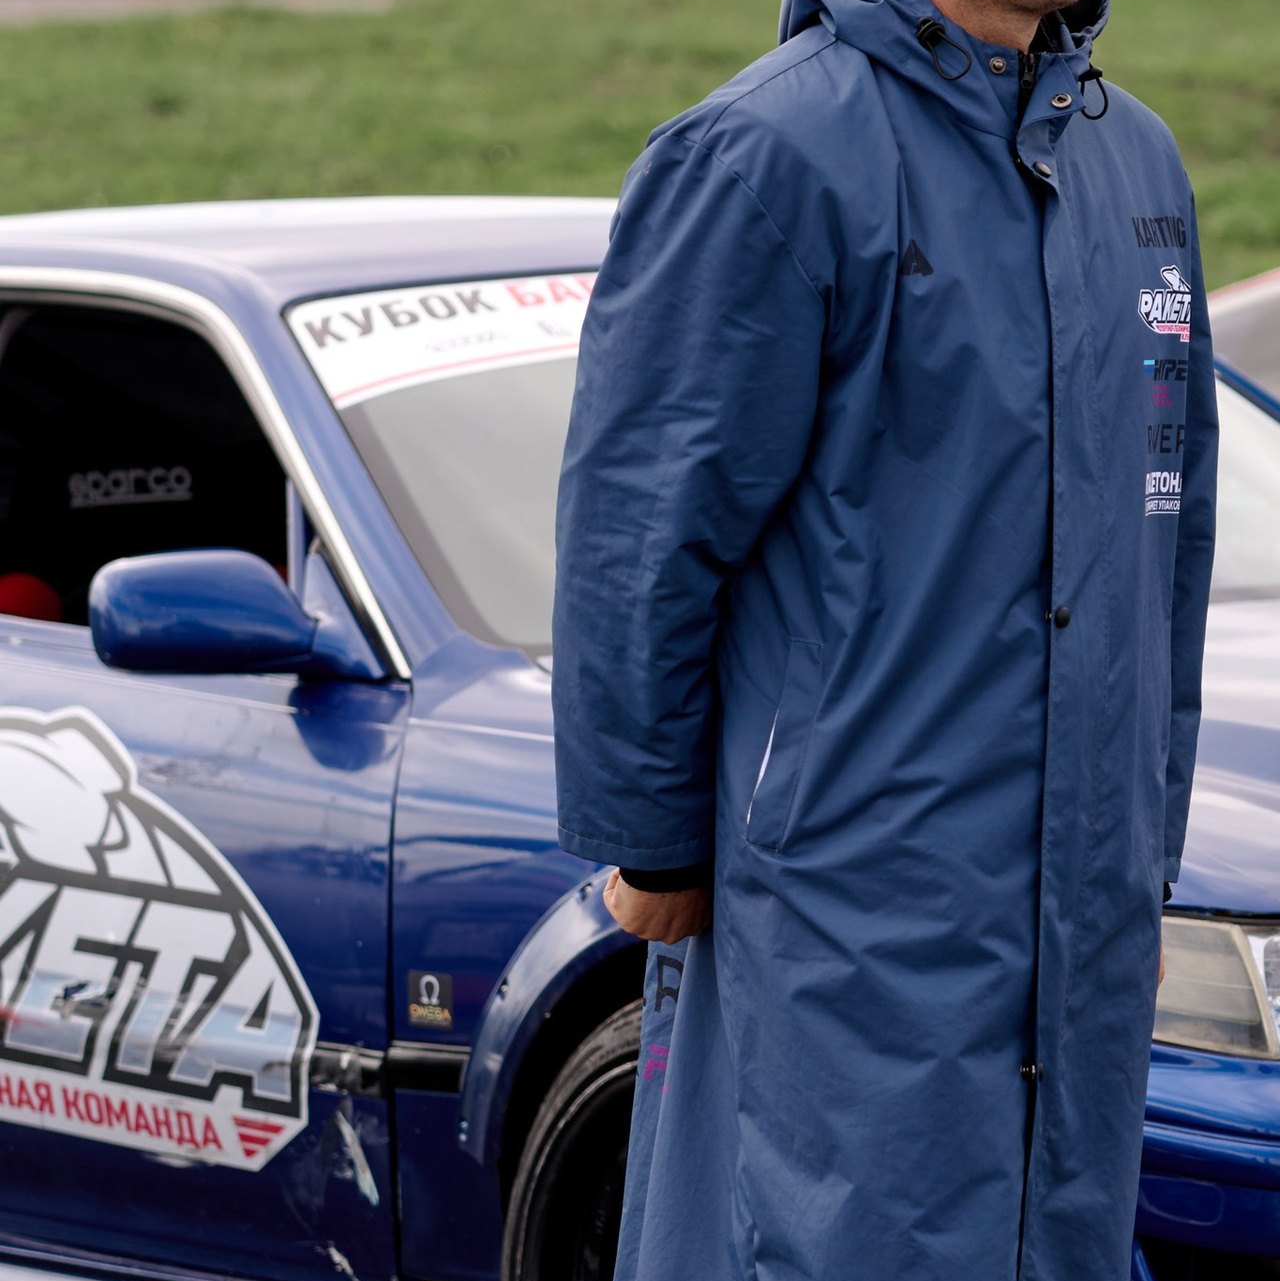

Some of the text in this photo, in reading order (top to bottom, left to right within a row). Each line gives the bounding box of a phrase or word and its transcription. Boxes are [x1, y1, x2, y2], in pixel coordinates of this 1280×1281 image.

[303, 289, 498, 349] КУБОК
[68, 465, 193, 507] sparco
[61, 1085, 224, 1152] КОМАНДА
